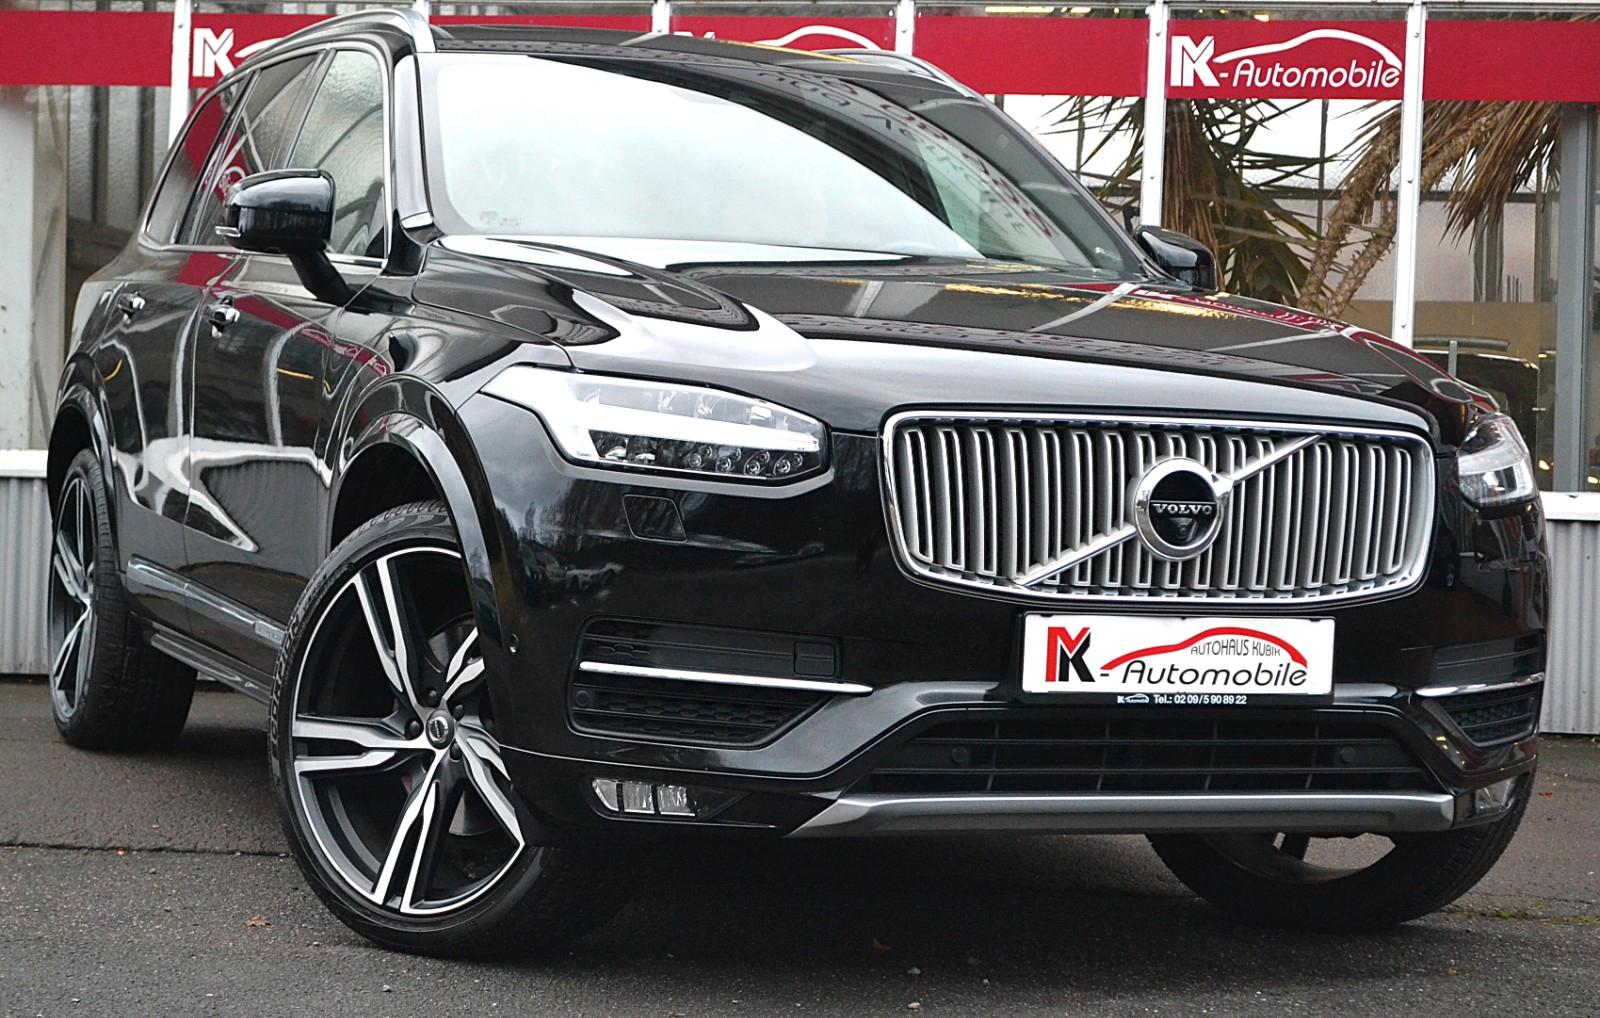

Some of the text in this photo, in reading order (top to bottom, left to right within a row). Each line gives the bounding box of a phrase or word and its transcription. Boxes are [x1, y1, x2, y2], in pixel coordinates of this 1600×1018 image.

[1152, 503, 1213, 515] VOLVO
[1190, 639, 1281, 657] AUTOHAUS KUBIK
